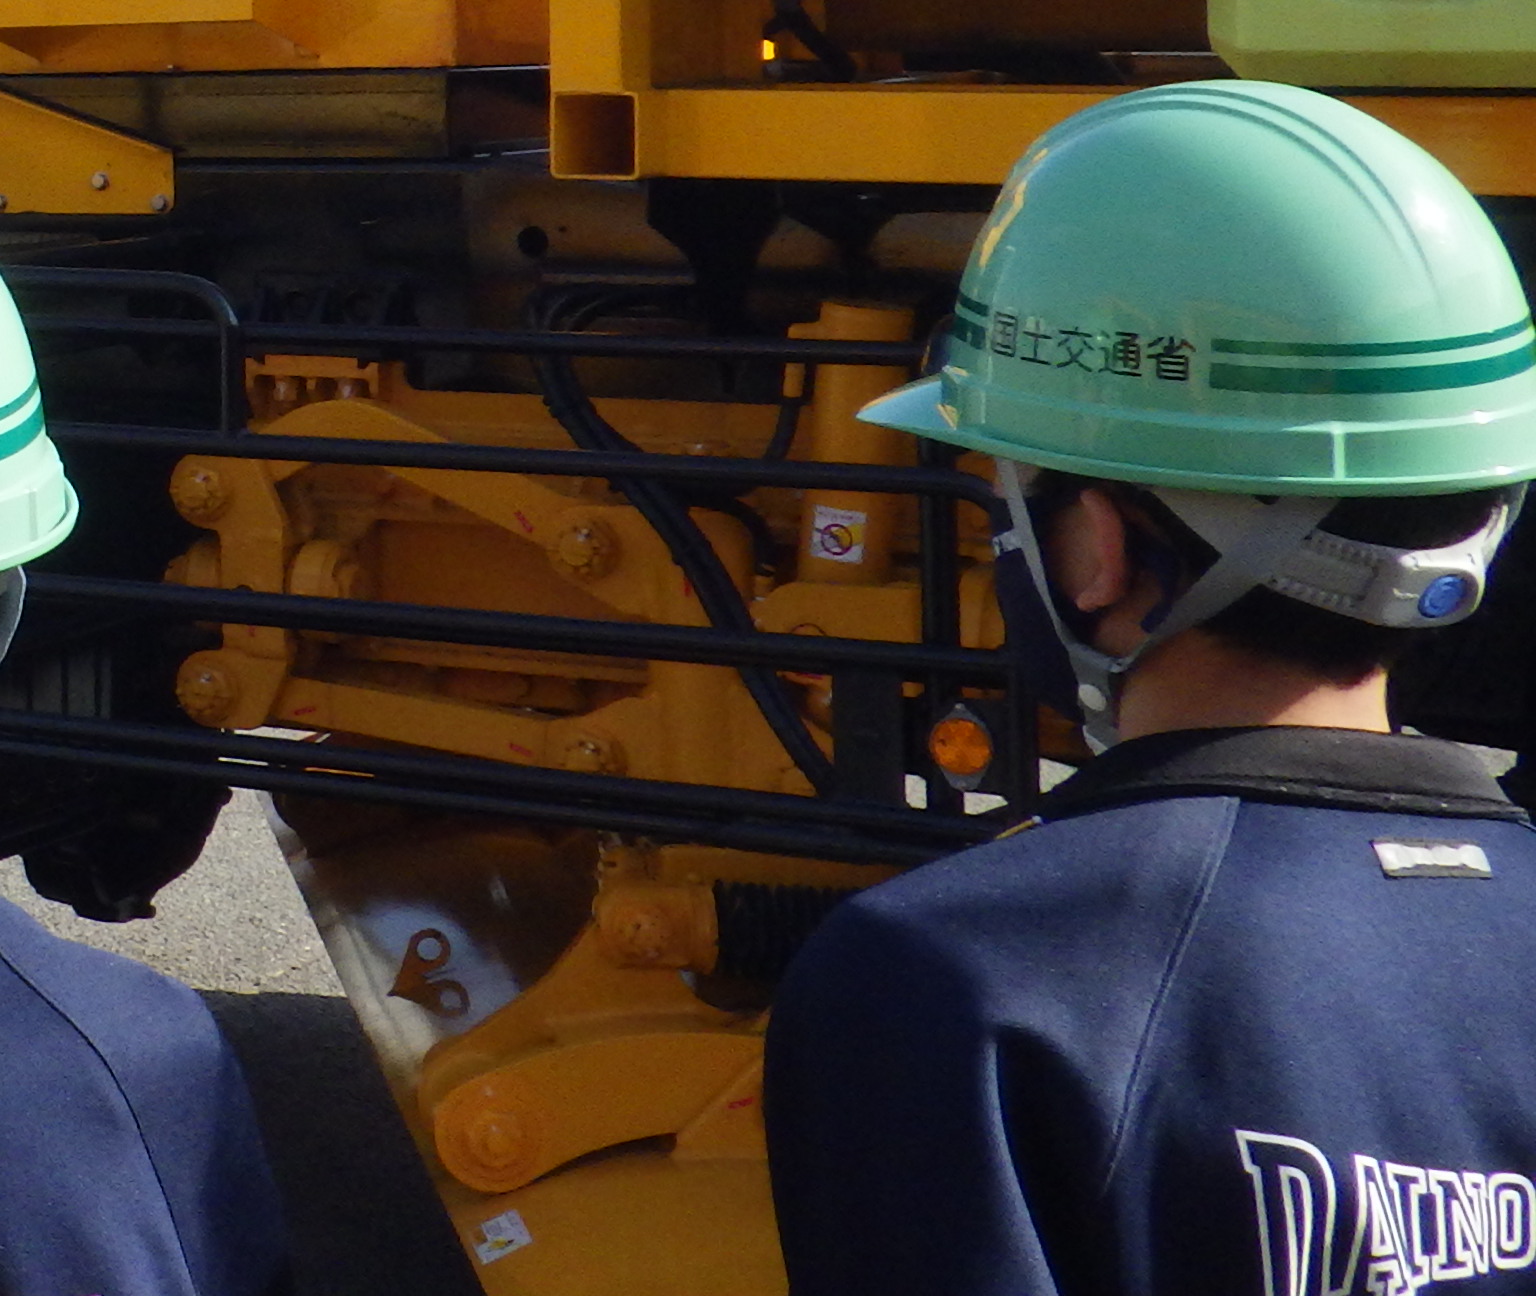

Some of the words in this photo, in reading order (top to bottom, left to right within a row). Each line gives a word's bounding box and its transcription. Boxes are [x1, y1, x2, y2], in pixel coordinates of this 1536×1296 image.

[990, 306, 1196, 383] 国土交通省
